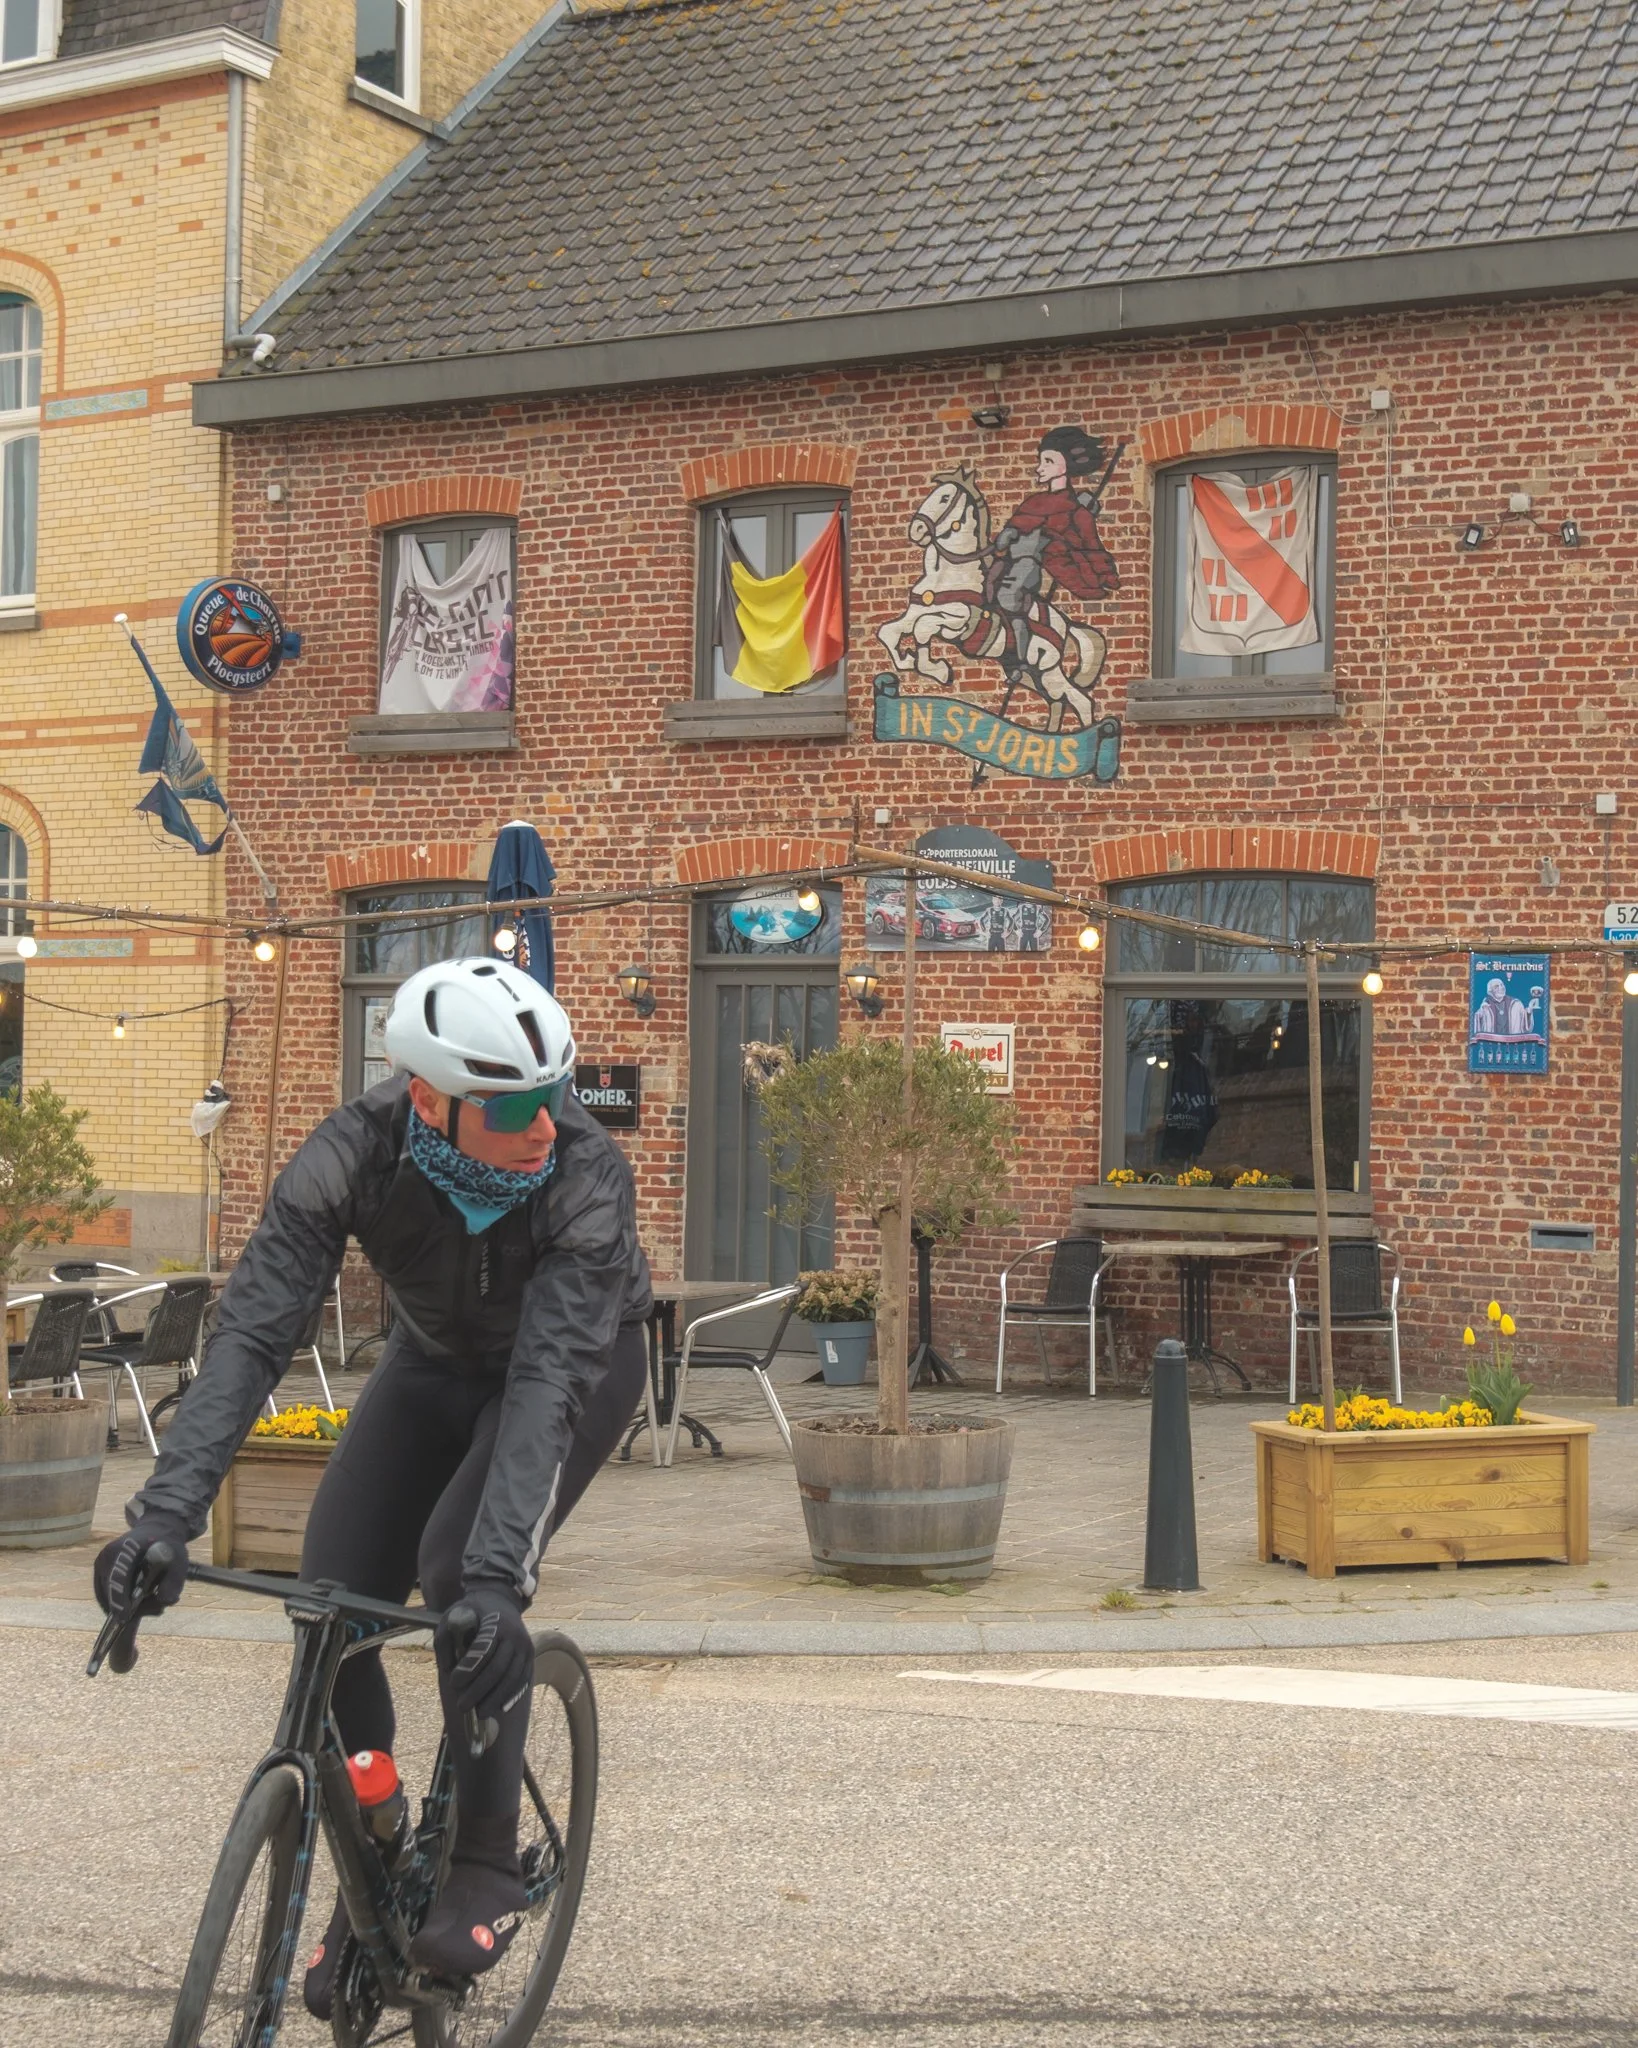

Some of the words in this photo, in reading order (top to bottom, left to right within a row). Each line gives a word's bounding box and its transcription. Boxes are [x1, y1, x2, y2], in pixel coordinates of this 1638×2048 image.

[194, 593, 226, 636] Queue
[236, 587, 250, 602] de
[250, 591, 281, 645] Charrue
[207, 655, 272, 687] Ploegsteert
[900, 702, 932, 737] IN
[976, 722, 1080, 774] JORIS
[920, 848, 998, 858] SUPPORTERSLOKAAL
[1493, 961, 1544, 971] Bernardus
[580, 1089, 633, 1105] OMER.
